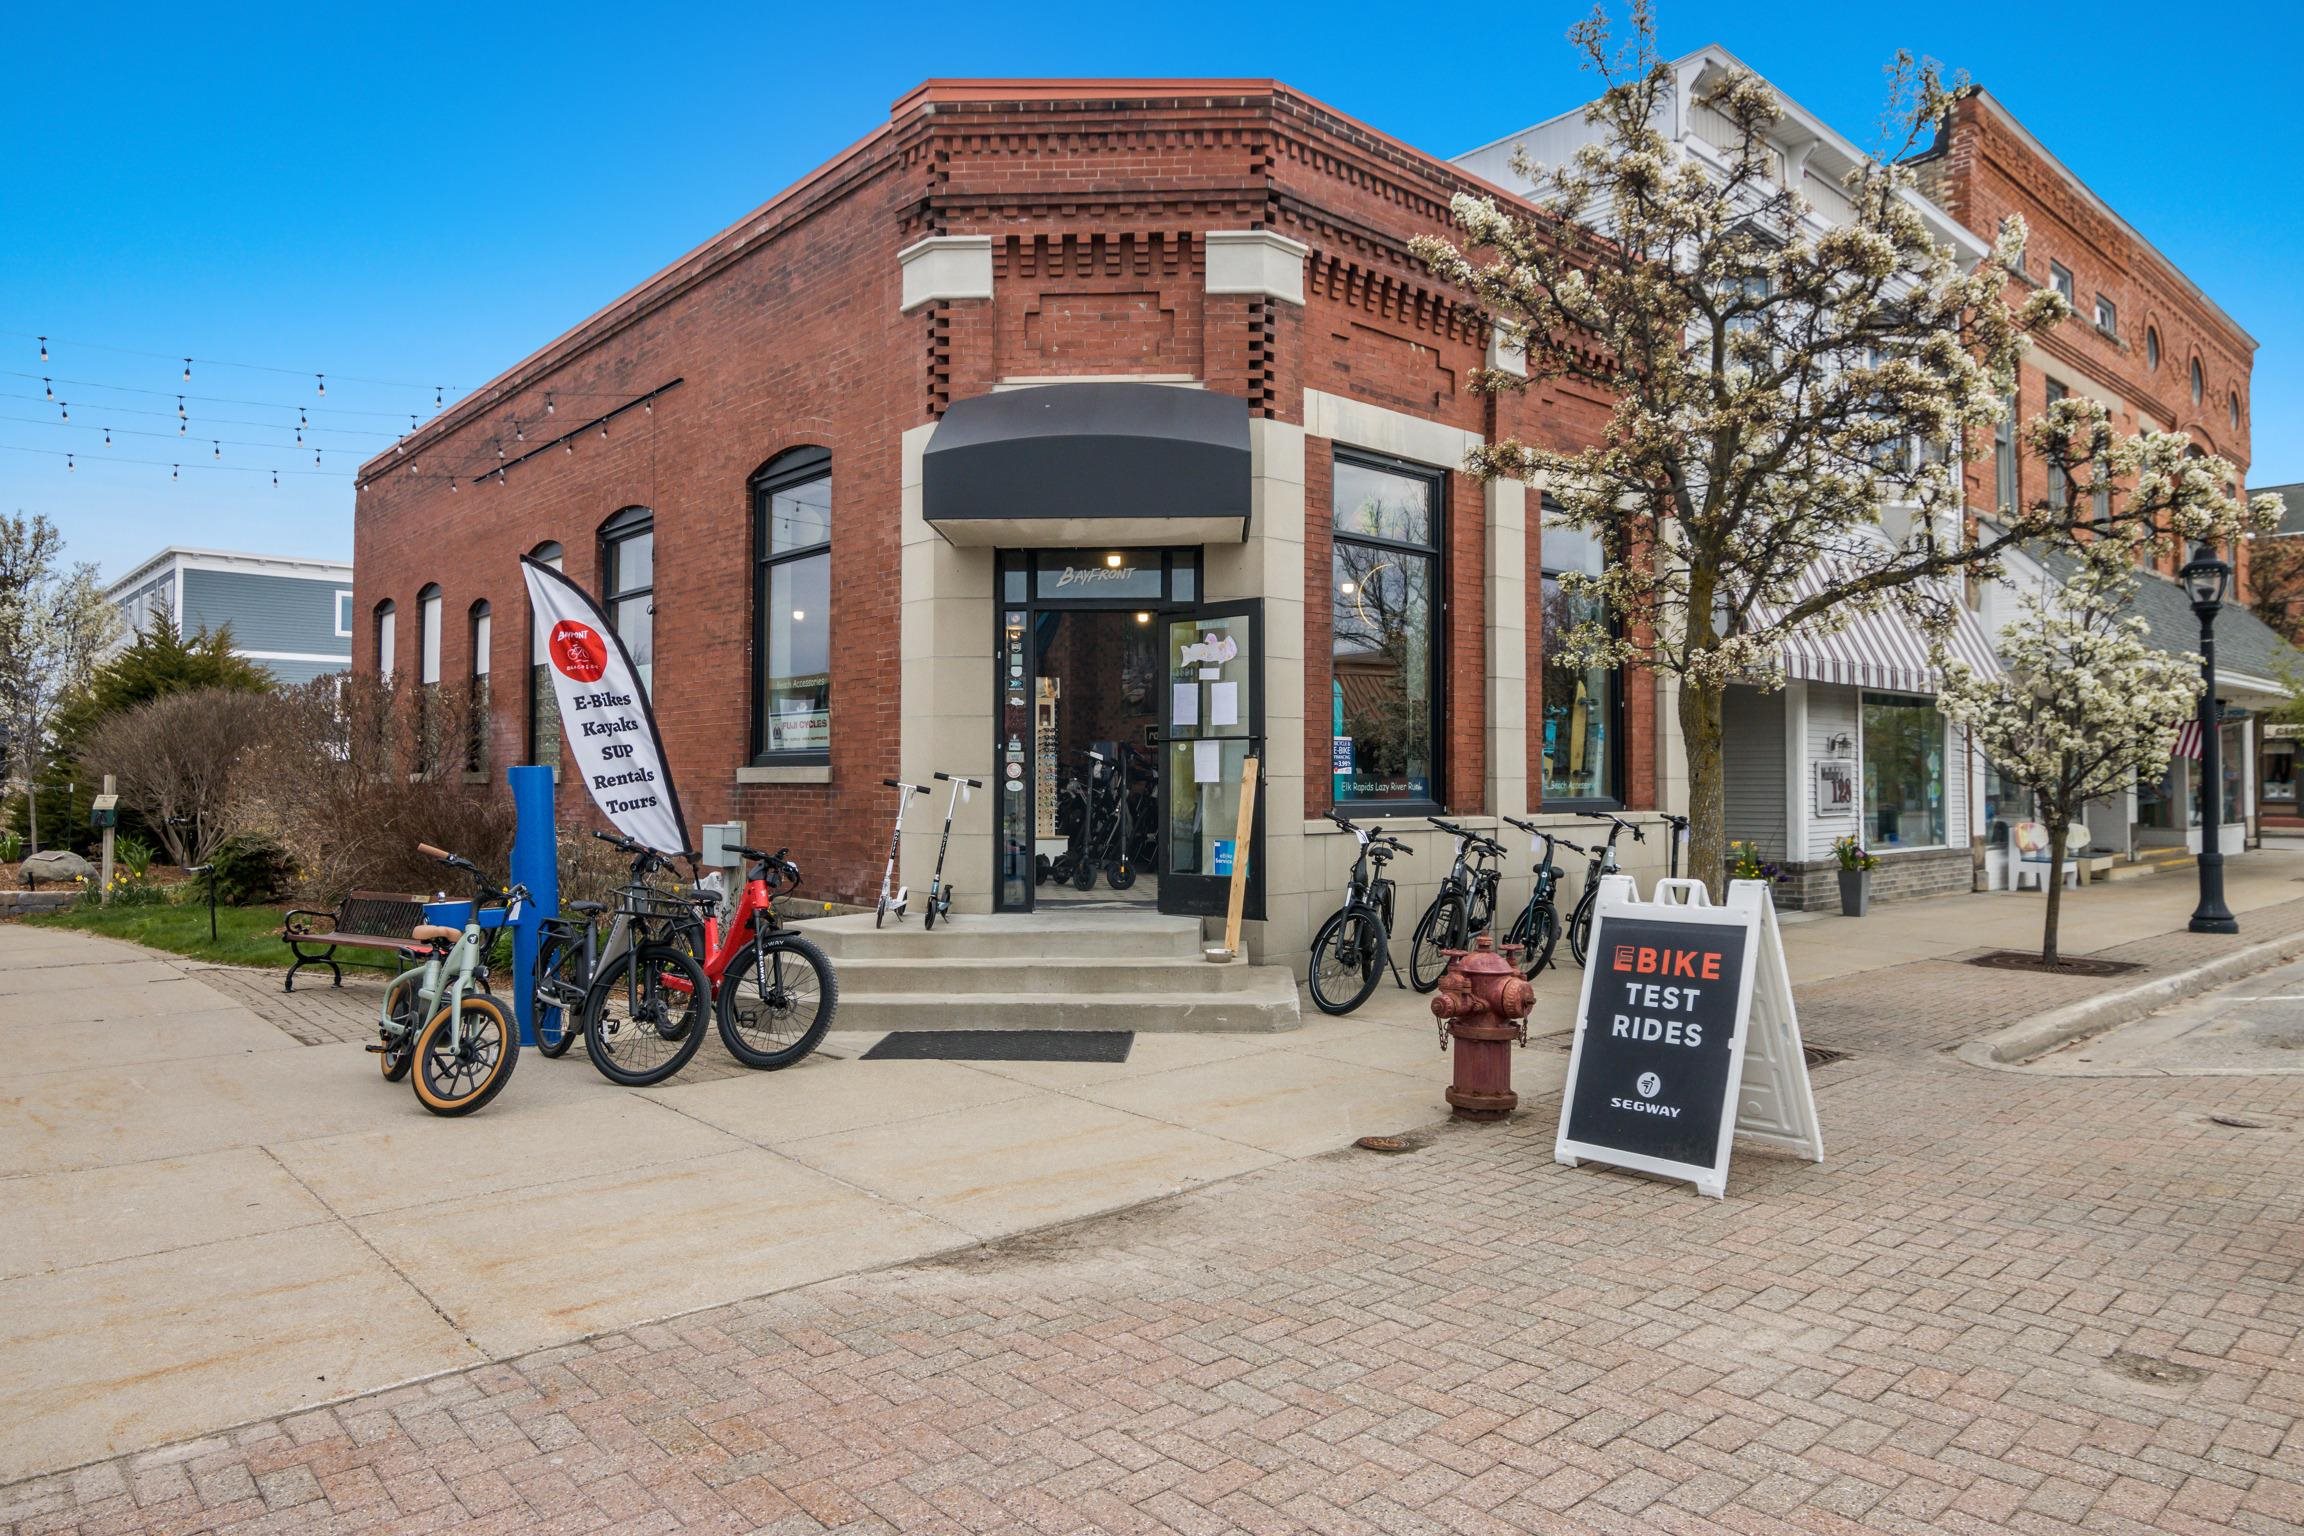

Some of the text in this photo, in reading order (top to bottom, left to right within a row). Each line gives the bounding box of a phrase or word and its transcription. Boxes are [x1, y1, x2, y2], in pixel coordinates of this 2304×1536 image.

[1056, 566, 1137, 588] BAYFRONT
[573, 692, 631, 710] E-Bikes
[582, 717, 638, 737] Kayaks
[799, 719, 827, 729] CYCLES
[602, 744, 633, 761] SUP
[1334, 746, 1351, 755] E-BIKE
[593, 767, 654, 790] Rentals
[1341, 782, 1351, 791] Elk
[1353, 782, 1374, 794] Rapids
[1375, 782, 1389, 792] Lazy
[1390, 782, 1407, 791] River
[606, 795, 657, 815] Tours
[1613, 945, 1722, 980] EBIKE
[1626, 982, 1701, 1012] TEST
[1611, 1015, 1703, 1048] RIDES
[1611, 1097, 1681, 1118] SEGWAY
